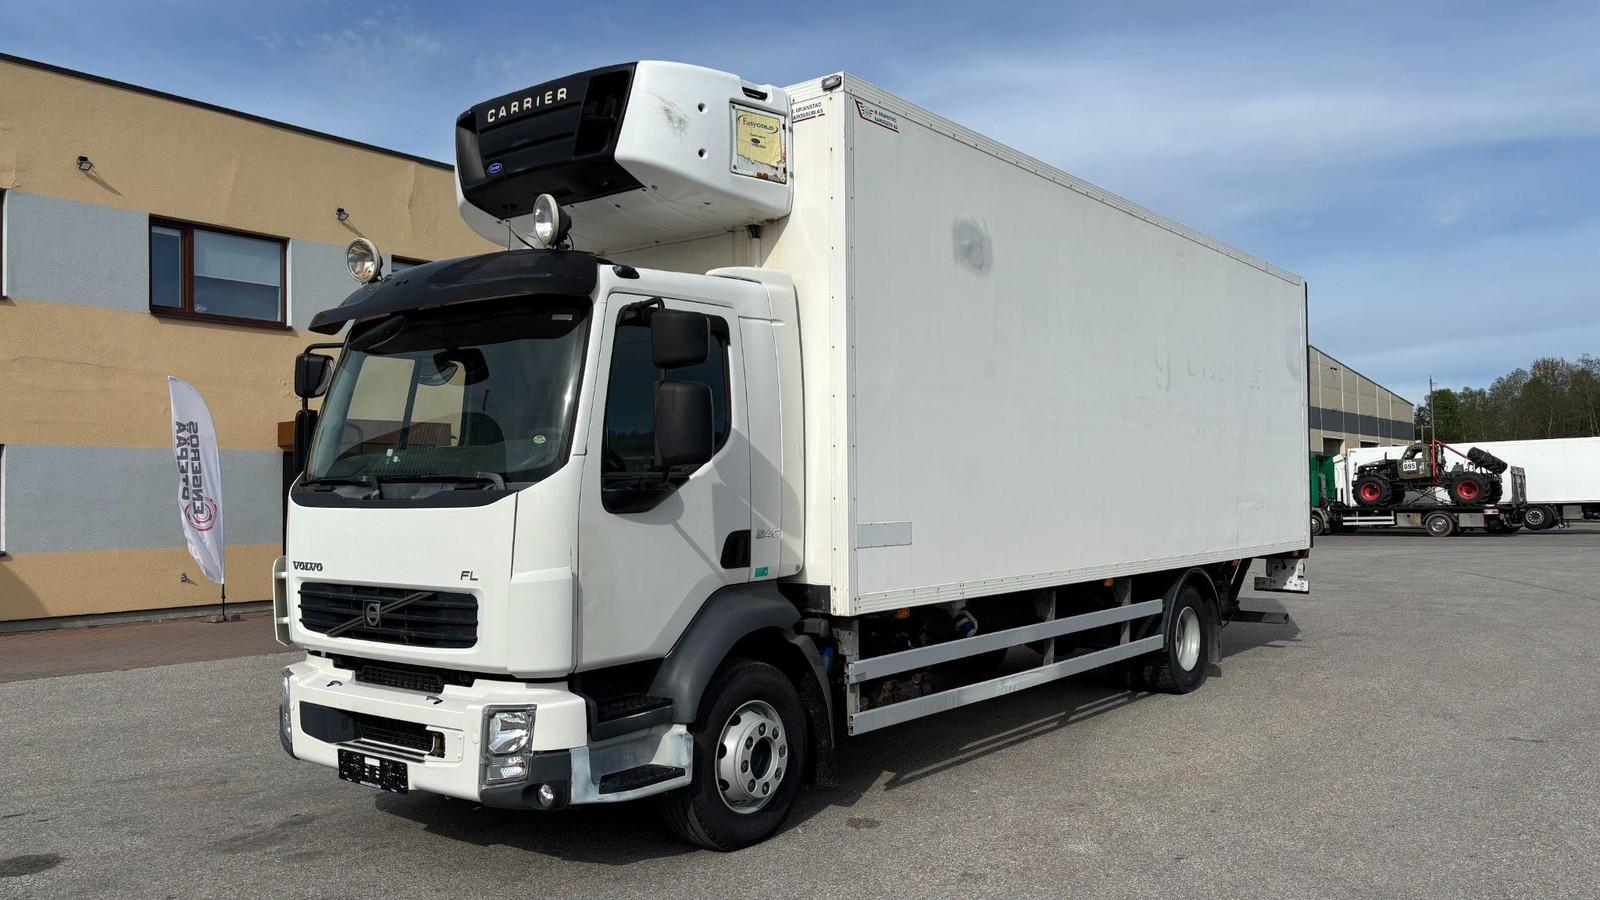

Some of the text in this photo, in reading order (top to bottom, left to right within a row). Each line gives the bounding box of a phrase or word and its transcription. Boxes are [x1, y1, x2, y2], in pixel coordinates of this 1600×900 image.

[487, 87, 567, 123] CARRIER
[792, 110, 817, 120] AROSSERI
[742, 117, 774, 131] EasyCOLD
[293, 561, 323, 572] VOLVO
[460, 571, 479, 581] FL
